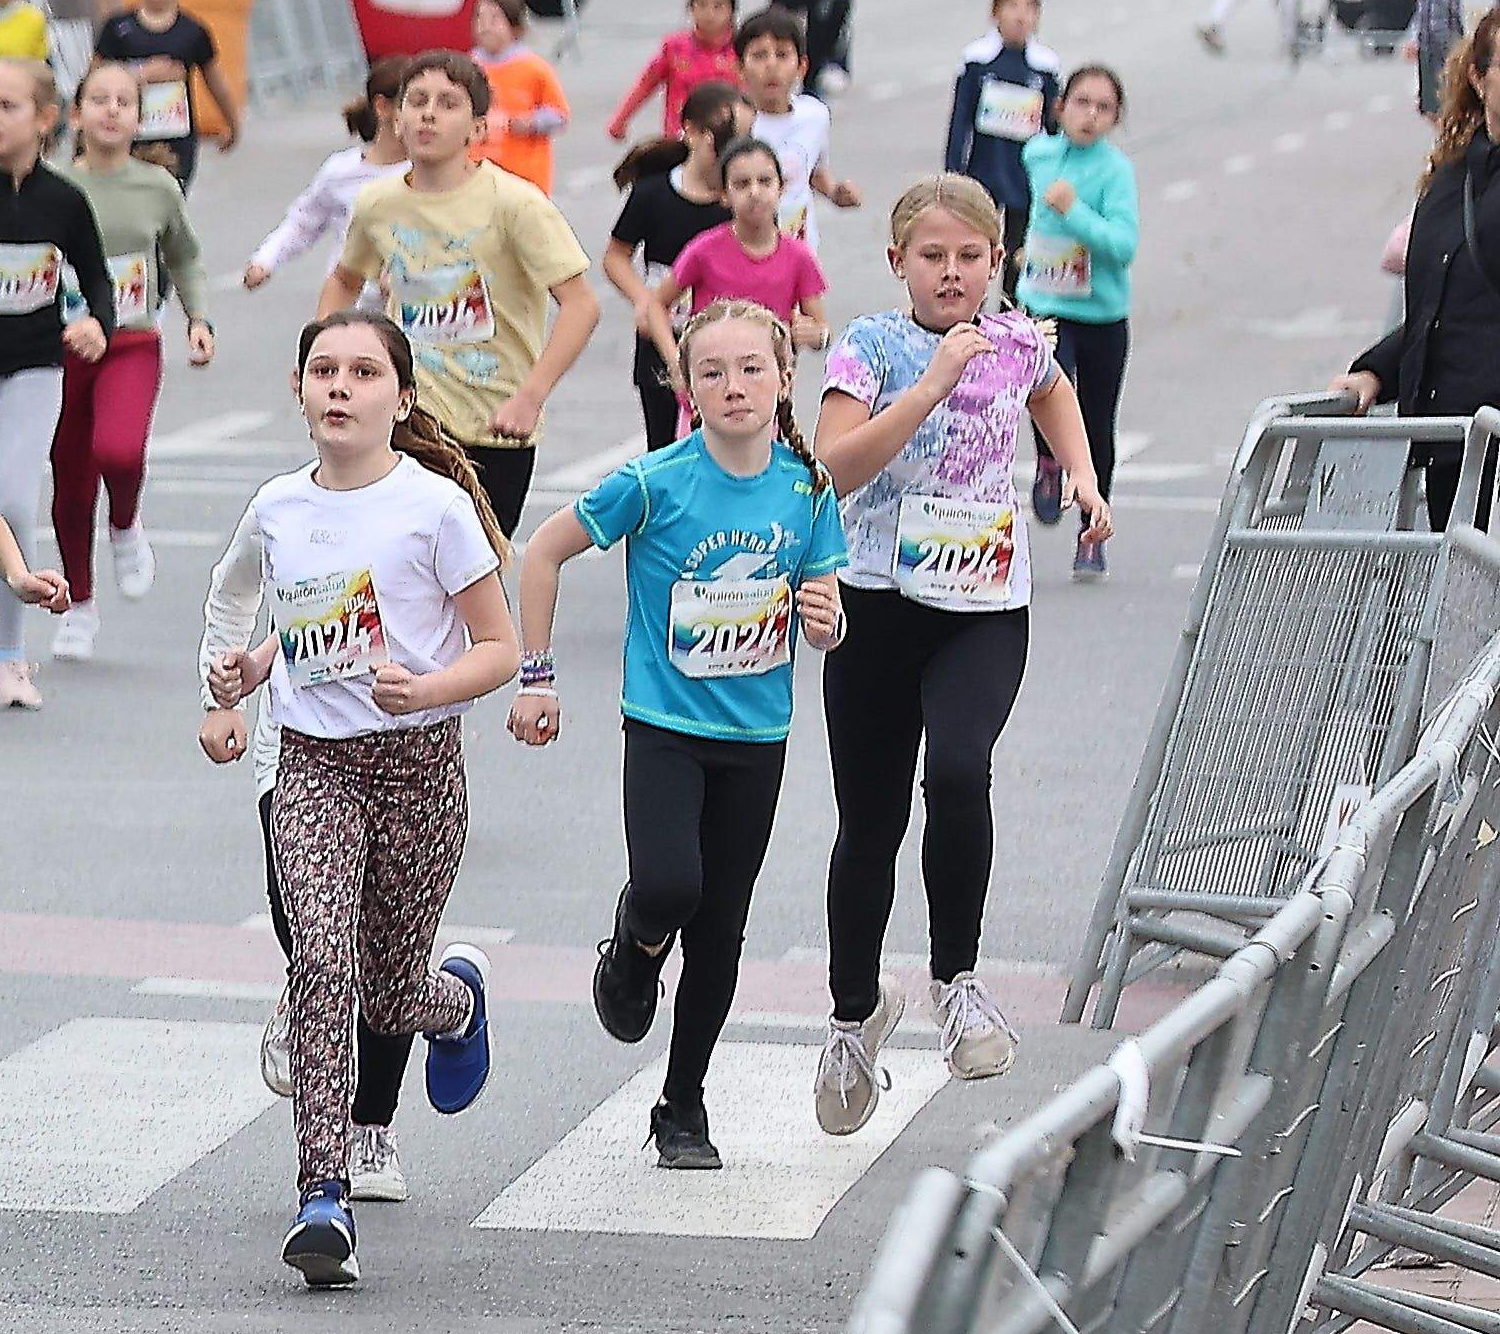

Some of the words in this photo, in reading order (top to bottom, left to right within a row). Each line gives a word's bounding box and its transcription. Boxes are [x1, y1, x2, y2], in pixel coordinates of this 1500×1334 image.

[685, 531, 727, 570] SUPER
[731, 529, 767, 554] HERO
[912, 540, 998, 582] 2024
[288, 612, 371, 668] 2024
[687, 617, 782, 659] 2024
